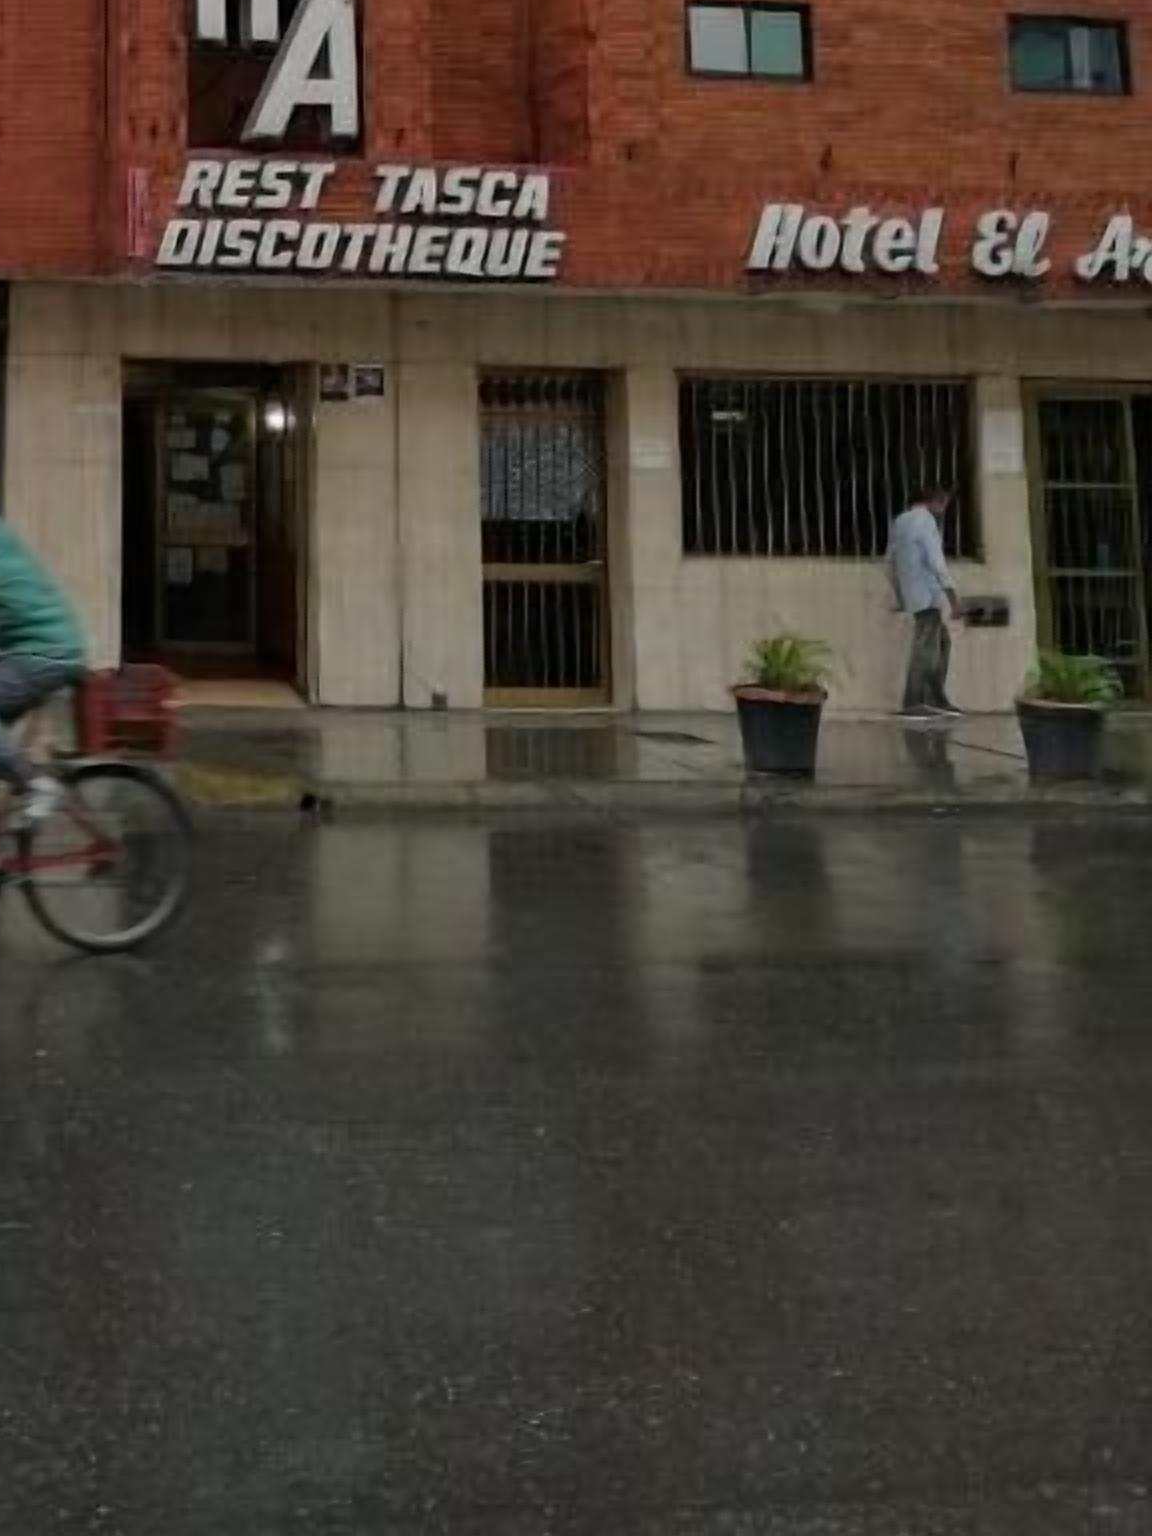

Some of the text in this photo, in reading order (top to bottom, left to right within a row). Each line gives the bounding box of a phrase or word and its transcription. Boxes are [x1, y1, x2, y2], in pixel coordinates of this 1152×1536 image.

[177, 160, 549, 220] REST TASCA
[156, 219, 566, 278] DISCOTHEQUE
[747, 202, 944, 273] Hotel
[972, 209, 1052, 278] El
